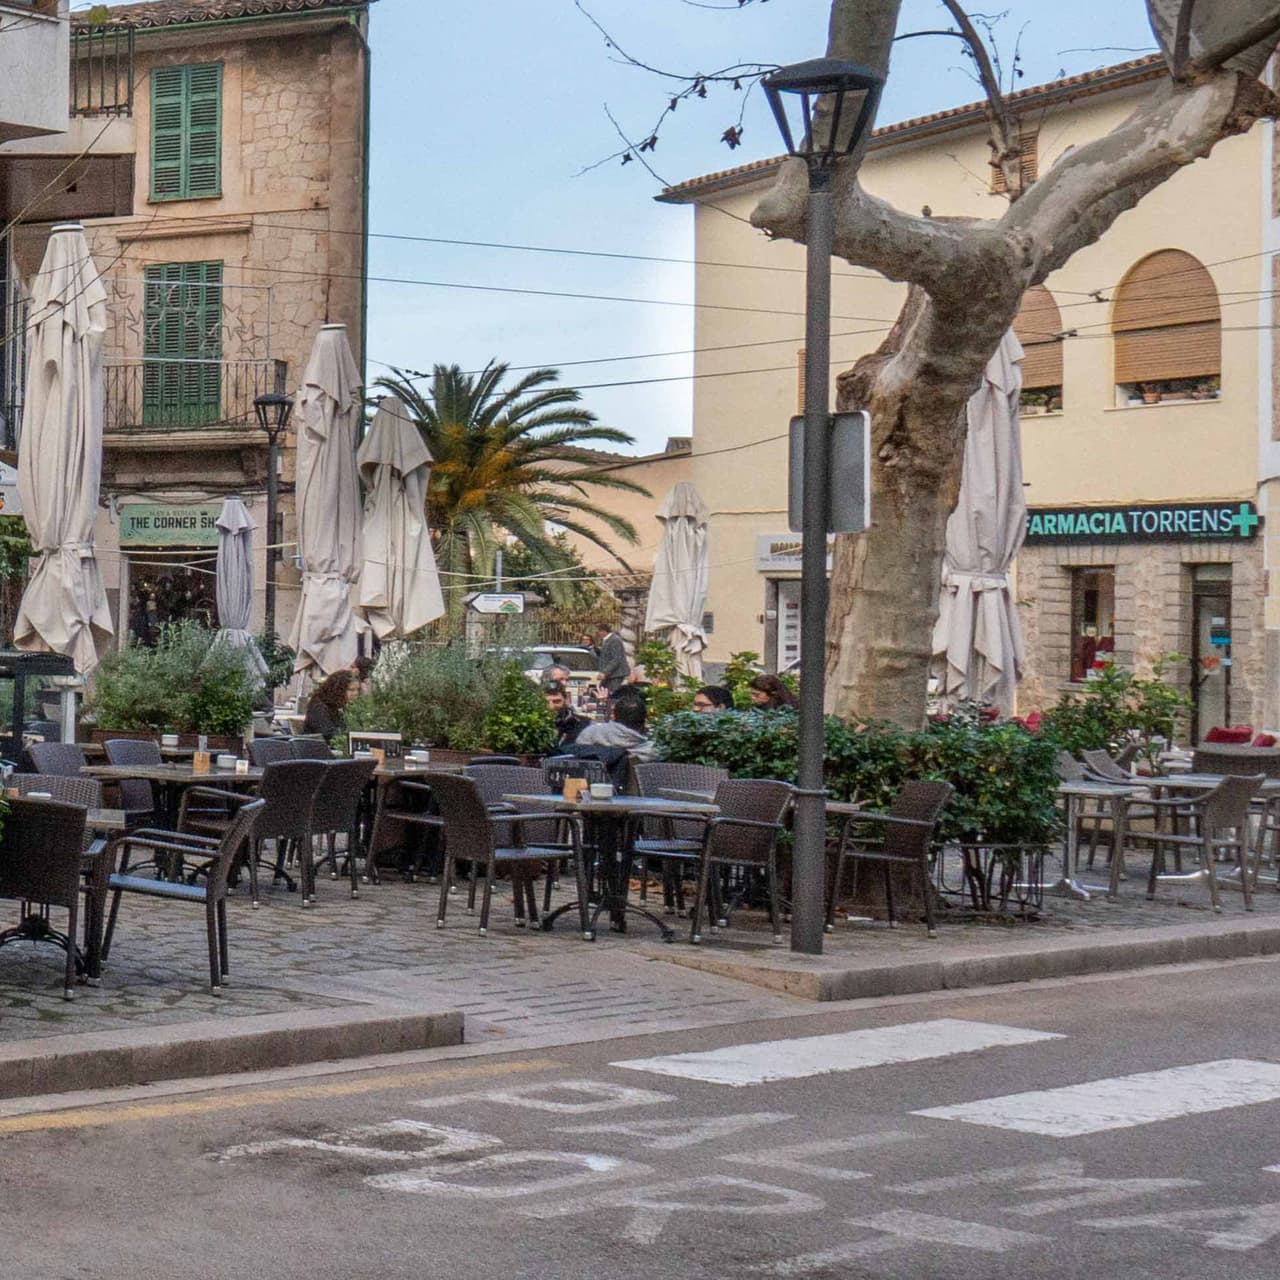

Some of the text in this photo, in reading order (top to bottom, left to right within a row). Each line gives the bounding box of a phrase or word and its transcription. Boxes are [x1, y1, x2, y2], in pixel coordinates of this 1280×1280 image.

[130, 517, 150, 529] THE
[154, 517, 197, 529] CORNER
[1129, 509, 1234, 533] TORRENS
[203, 1118, 1058, 1276] PORT
